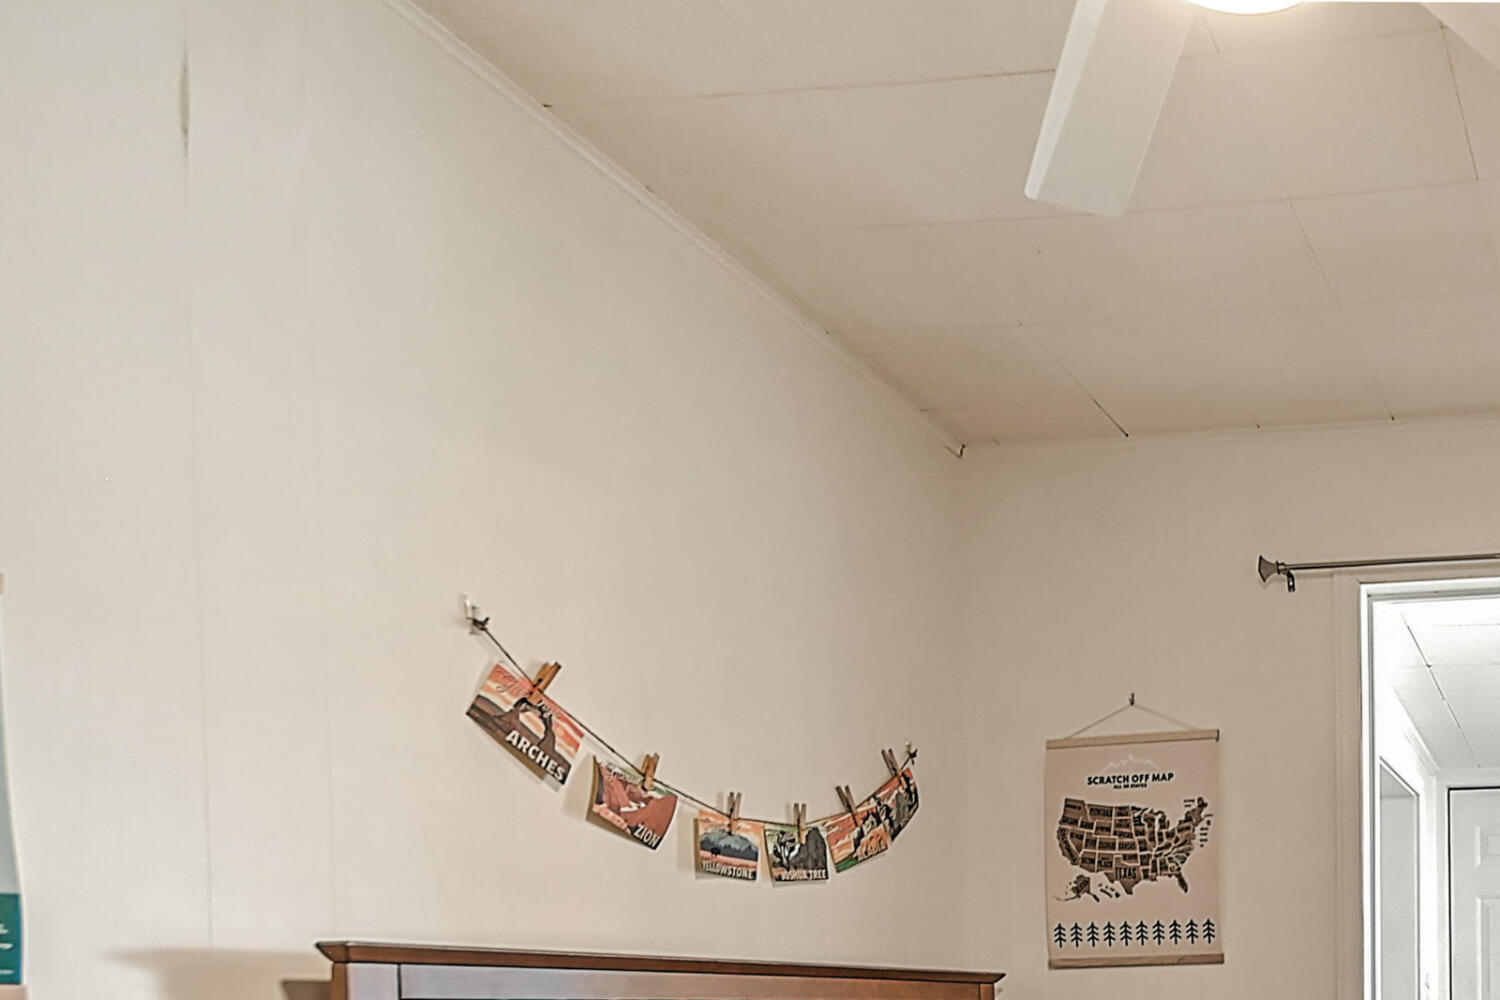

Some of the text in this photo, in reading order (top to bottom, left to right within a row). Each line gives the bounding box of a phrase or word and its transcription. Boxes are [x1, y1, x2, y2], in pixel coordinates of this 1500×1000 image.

[505, 729, 566, 781] ARCHES
[1087, 773, 1174, 785] SCRATCH OFF MAP
[633, 823, 661, 848] ZION
[701, 860, 754, 879] YELLOWSTONE
[809, 868, 827, 880] TREE
[1115, 866, 1137, 880] TEXAS
